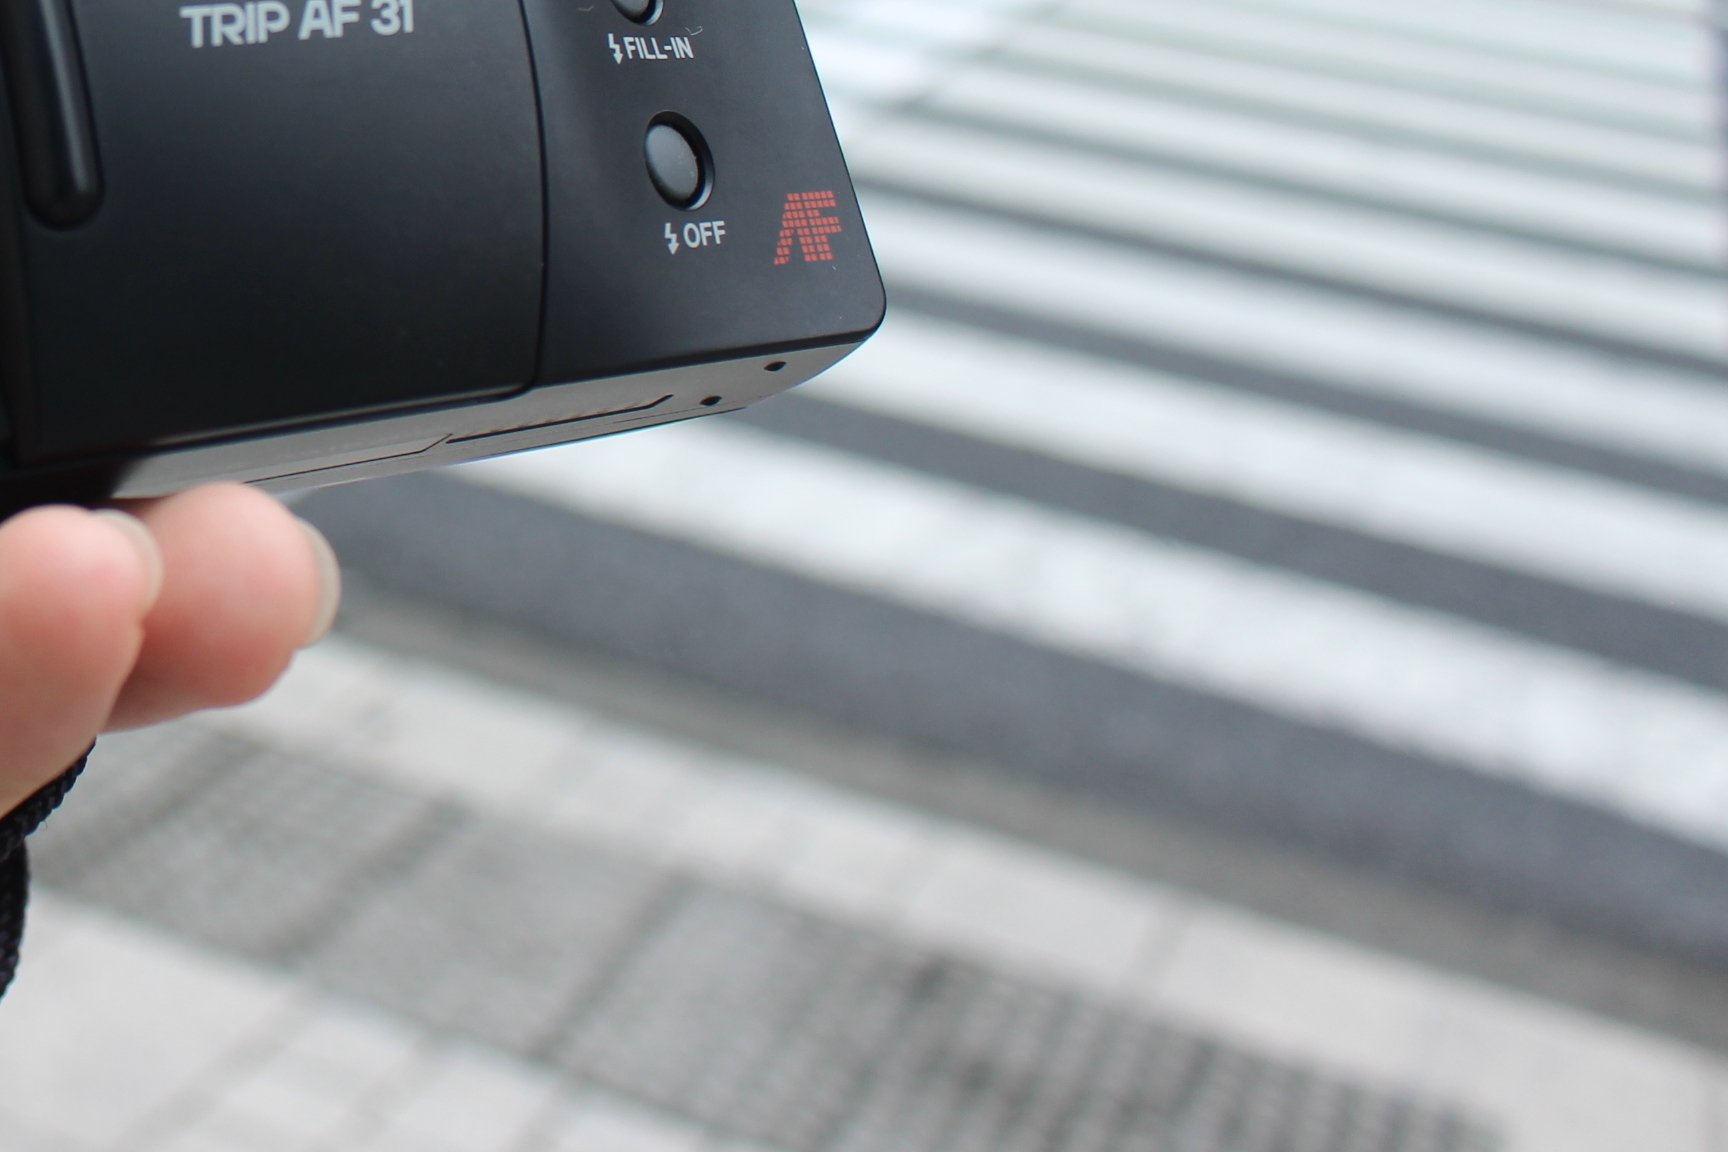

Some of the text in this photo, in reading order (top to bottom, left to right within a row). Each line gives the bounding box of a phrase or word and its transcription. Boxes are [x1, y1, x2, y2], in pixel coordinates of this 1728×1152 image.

[179, 0, 290, 48] TRIP
[623, 36, 694, 59] FILL-IN
[683, 220, 726, 248] OFF
[774, 190, 842, 265] AF
